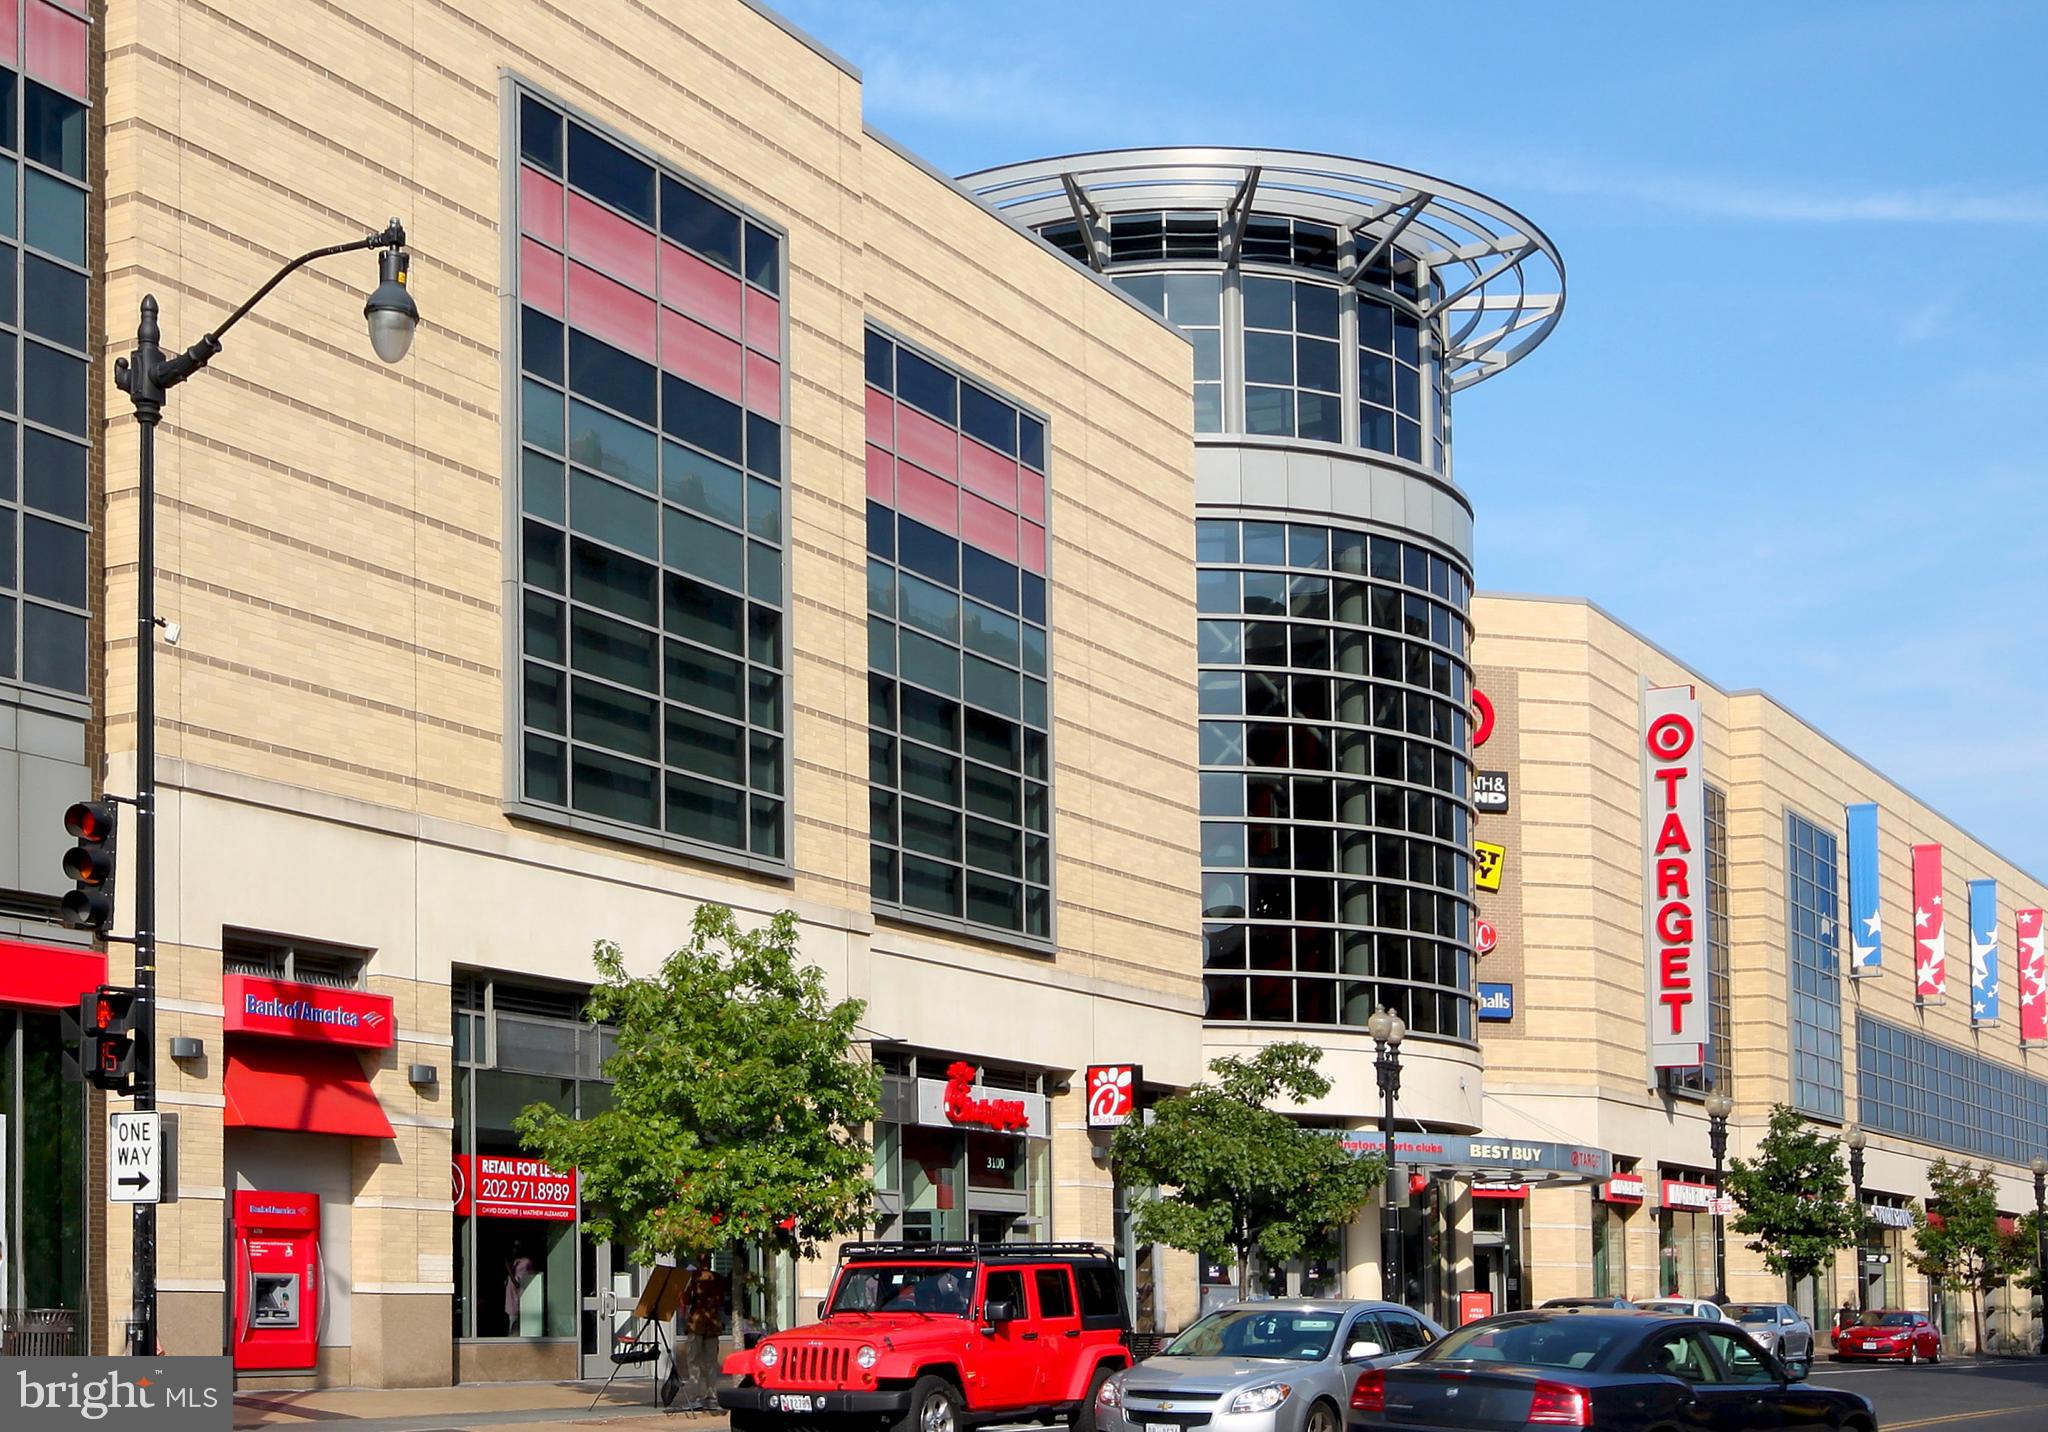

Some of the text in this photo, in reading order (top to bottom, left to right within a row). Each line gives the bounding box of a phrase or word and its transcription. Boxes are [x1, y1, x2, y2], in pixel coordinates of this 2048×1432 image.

[1655, 767, 1692, 1034] TARGET
[245, 993, 359, 1027] Bank of America
[119, 1122, 150, 1141] ONE
[118, 1147, 151, 1165] WAY
[1379, 1141, 1413, 1152] sorts
[1415, 1142, 1443, 1153] clubs
[1469, 1143, 1542, 1162] BEST BUY
[482, 1159, 514, 1175] RETAIL
[517, 1162, 537, 1177] FOR
[986, 1157, 1005, 1169] 3100
[482, 1178, 570, 1202] 202.971.8989
